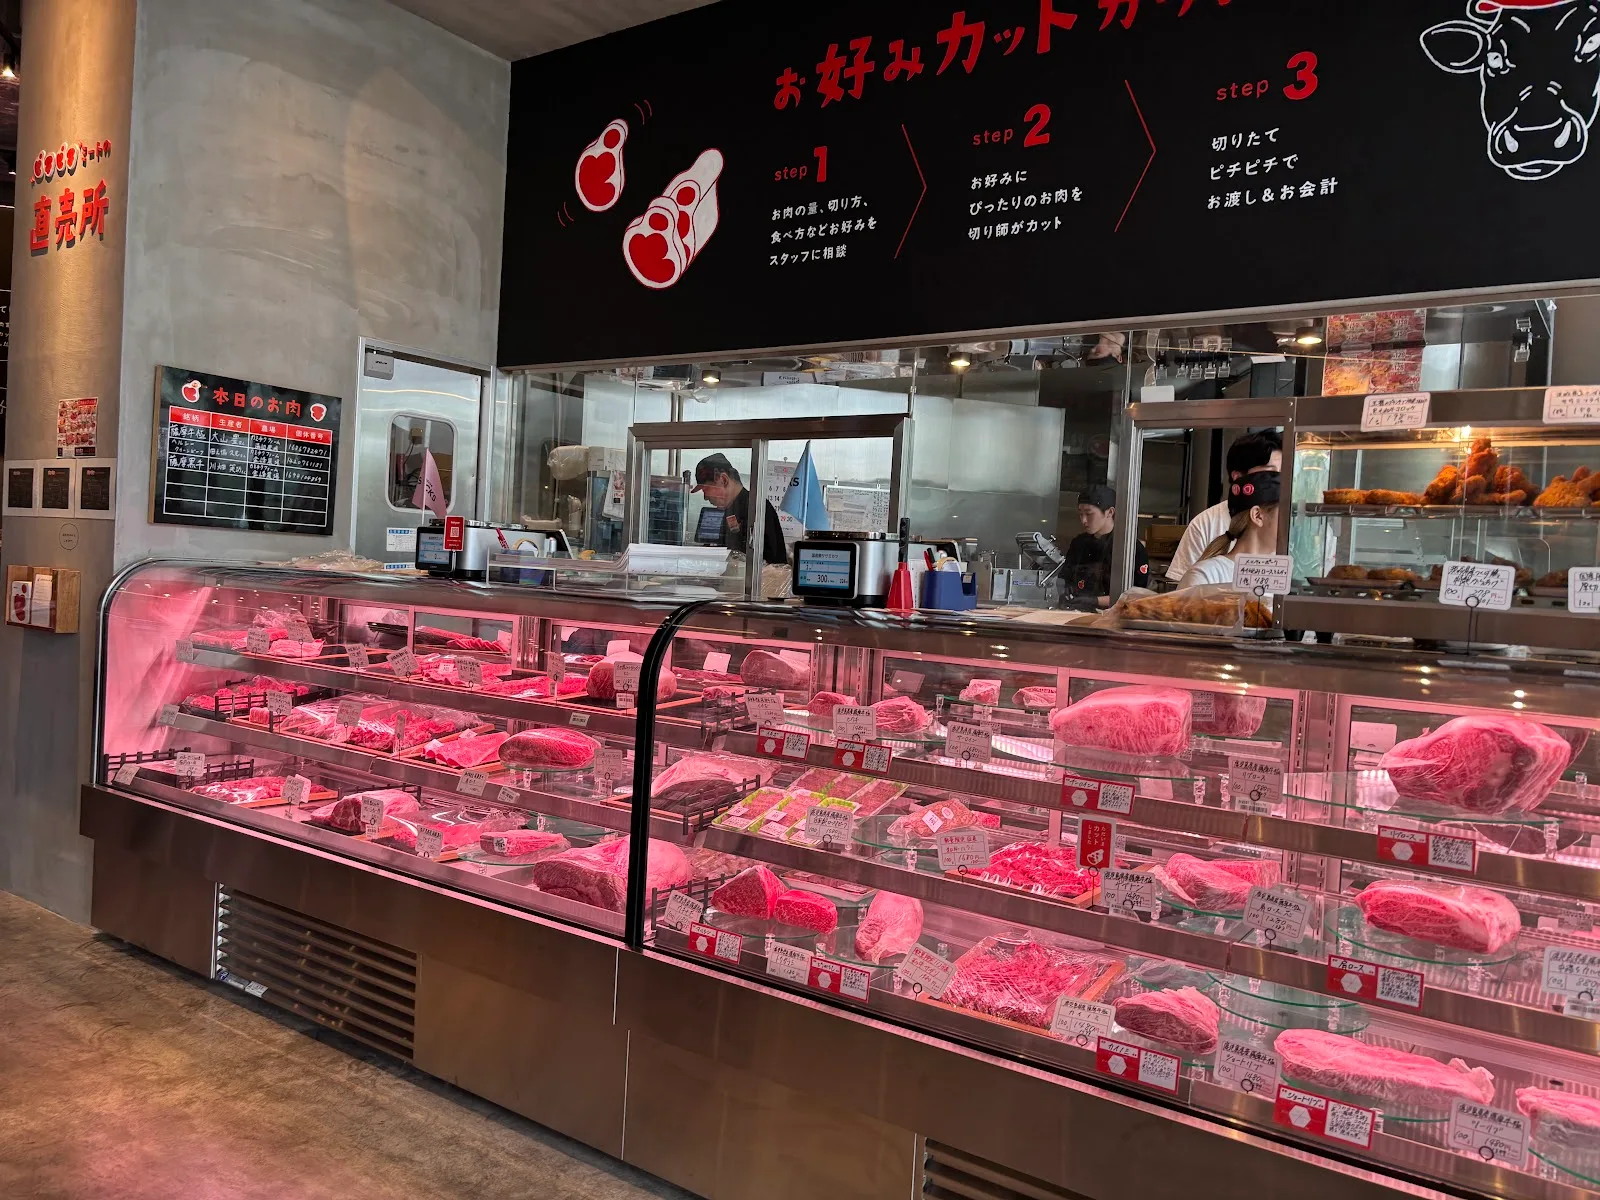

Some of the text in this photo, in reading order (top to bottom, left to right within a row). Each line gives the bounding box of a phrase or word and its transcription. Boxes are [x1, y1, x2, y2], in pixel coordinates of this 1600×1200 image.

[1216, 51, 1318, 100] step 3
[973, 103, 1051, 148] step 2
[1212, 127, 1280, 152] 切りたて
[774, 145, 828, 183] step 1
[1210, 153, 1299, 181] ピチピチで
[971, 170, 1028, 190] お好みに
[30, 178, 109, 250] 直売所
[771, 195, 868, 221] お肉の量、切り方、
[969, 186, 1083, 216] ぴったりのお肉を
[771, 216, 877, 244] 食べ方などお好みを
[968, 216, 1062, 240] 切り師がカット
[769, 244, 847, 265] スタッフに相談
[212, 386, 302, 418] 本日のお肉
[218, 419, 243, 429] 生産者
[295, 429, 324, 441] 個体番号
[1339, 960, 1365, 974] 肩ロース
[1287, 1092, 1322, 1107] ショートリブ
